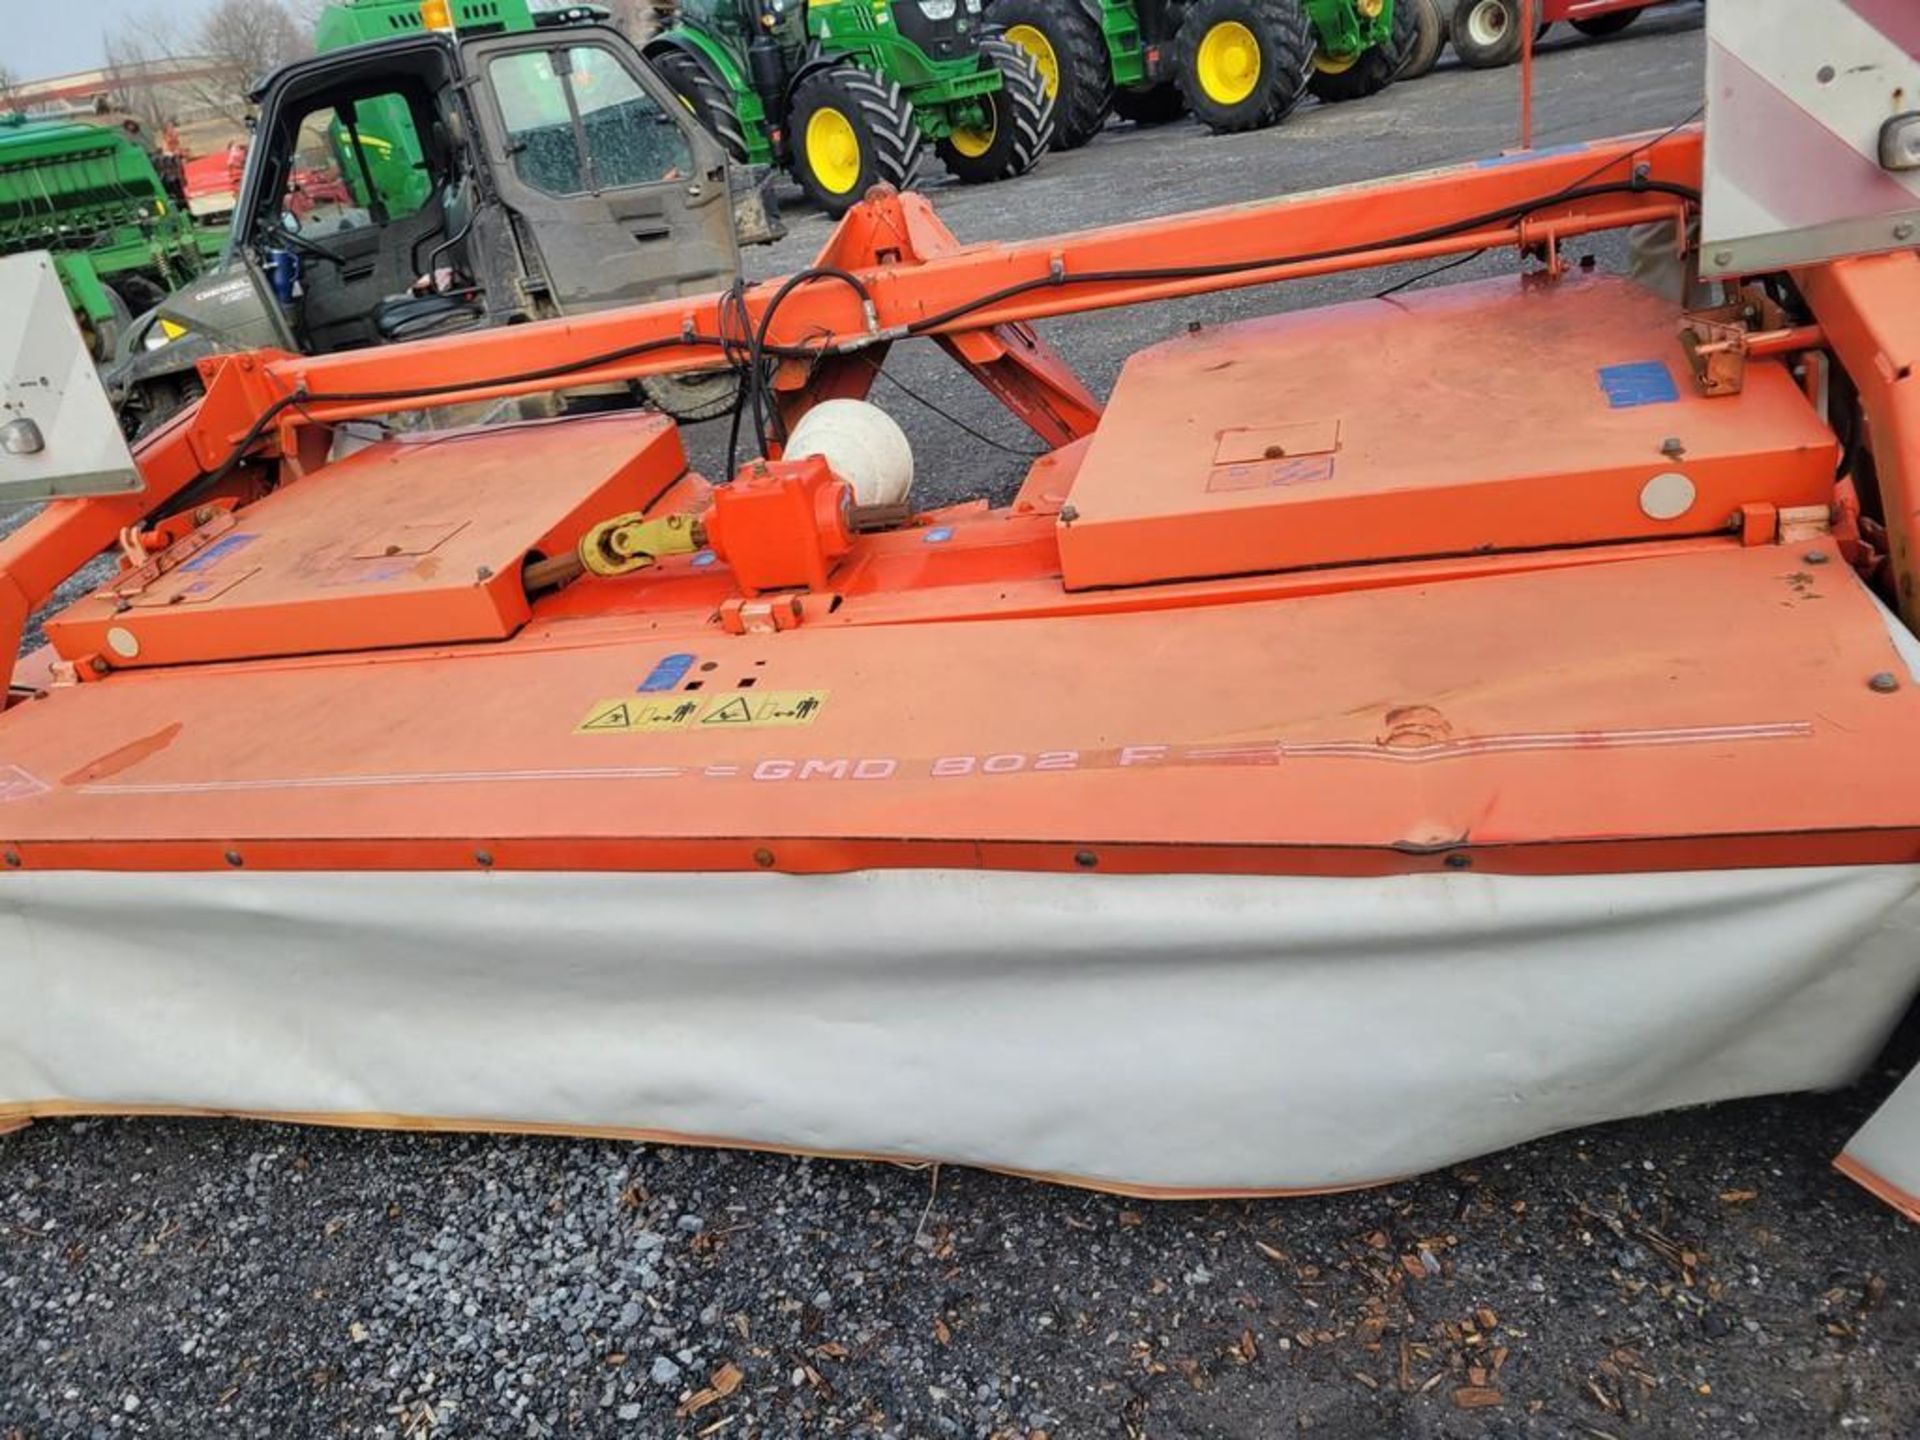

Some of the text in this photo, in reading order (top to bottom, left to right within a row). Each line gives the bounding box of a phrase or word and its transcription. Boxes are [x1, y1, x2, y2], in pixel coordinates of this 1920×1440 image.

[753, 745, 1171, 780] GMD 802 F
